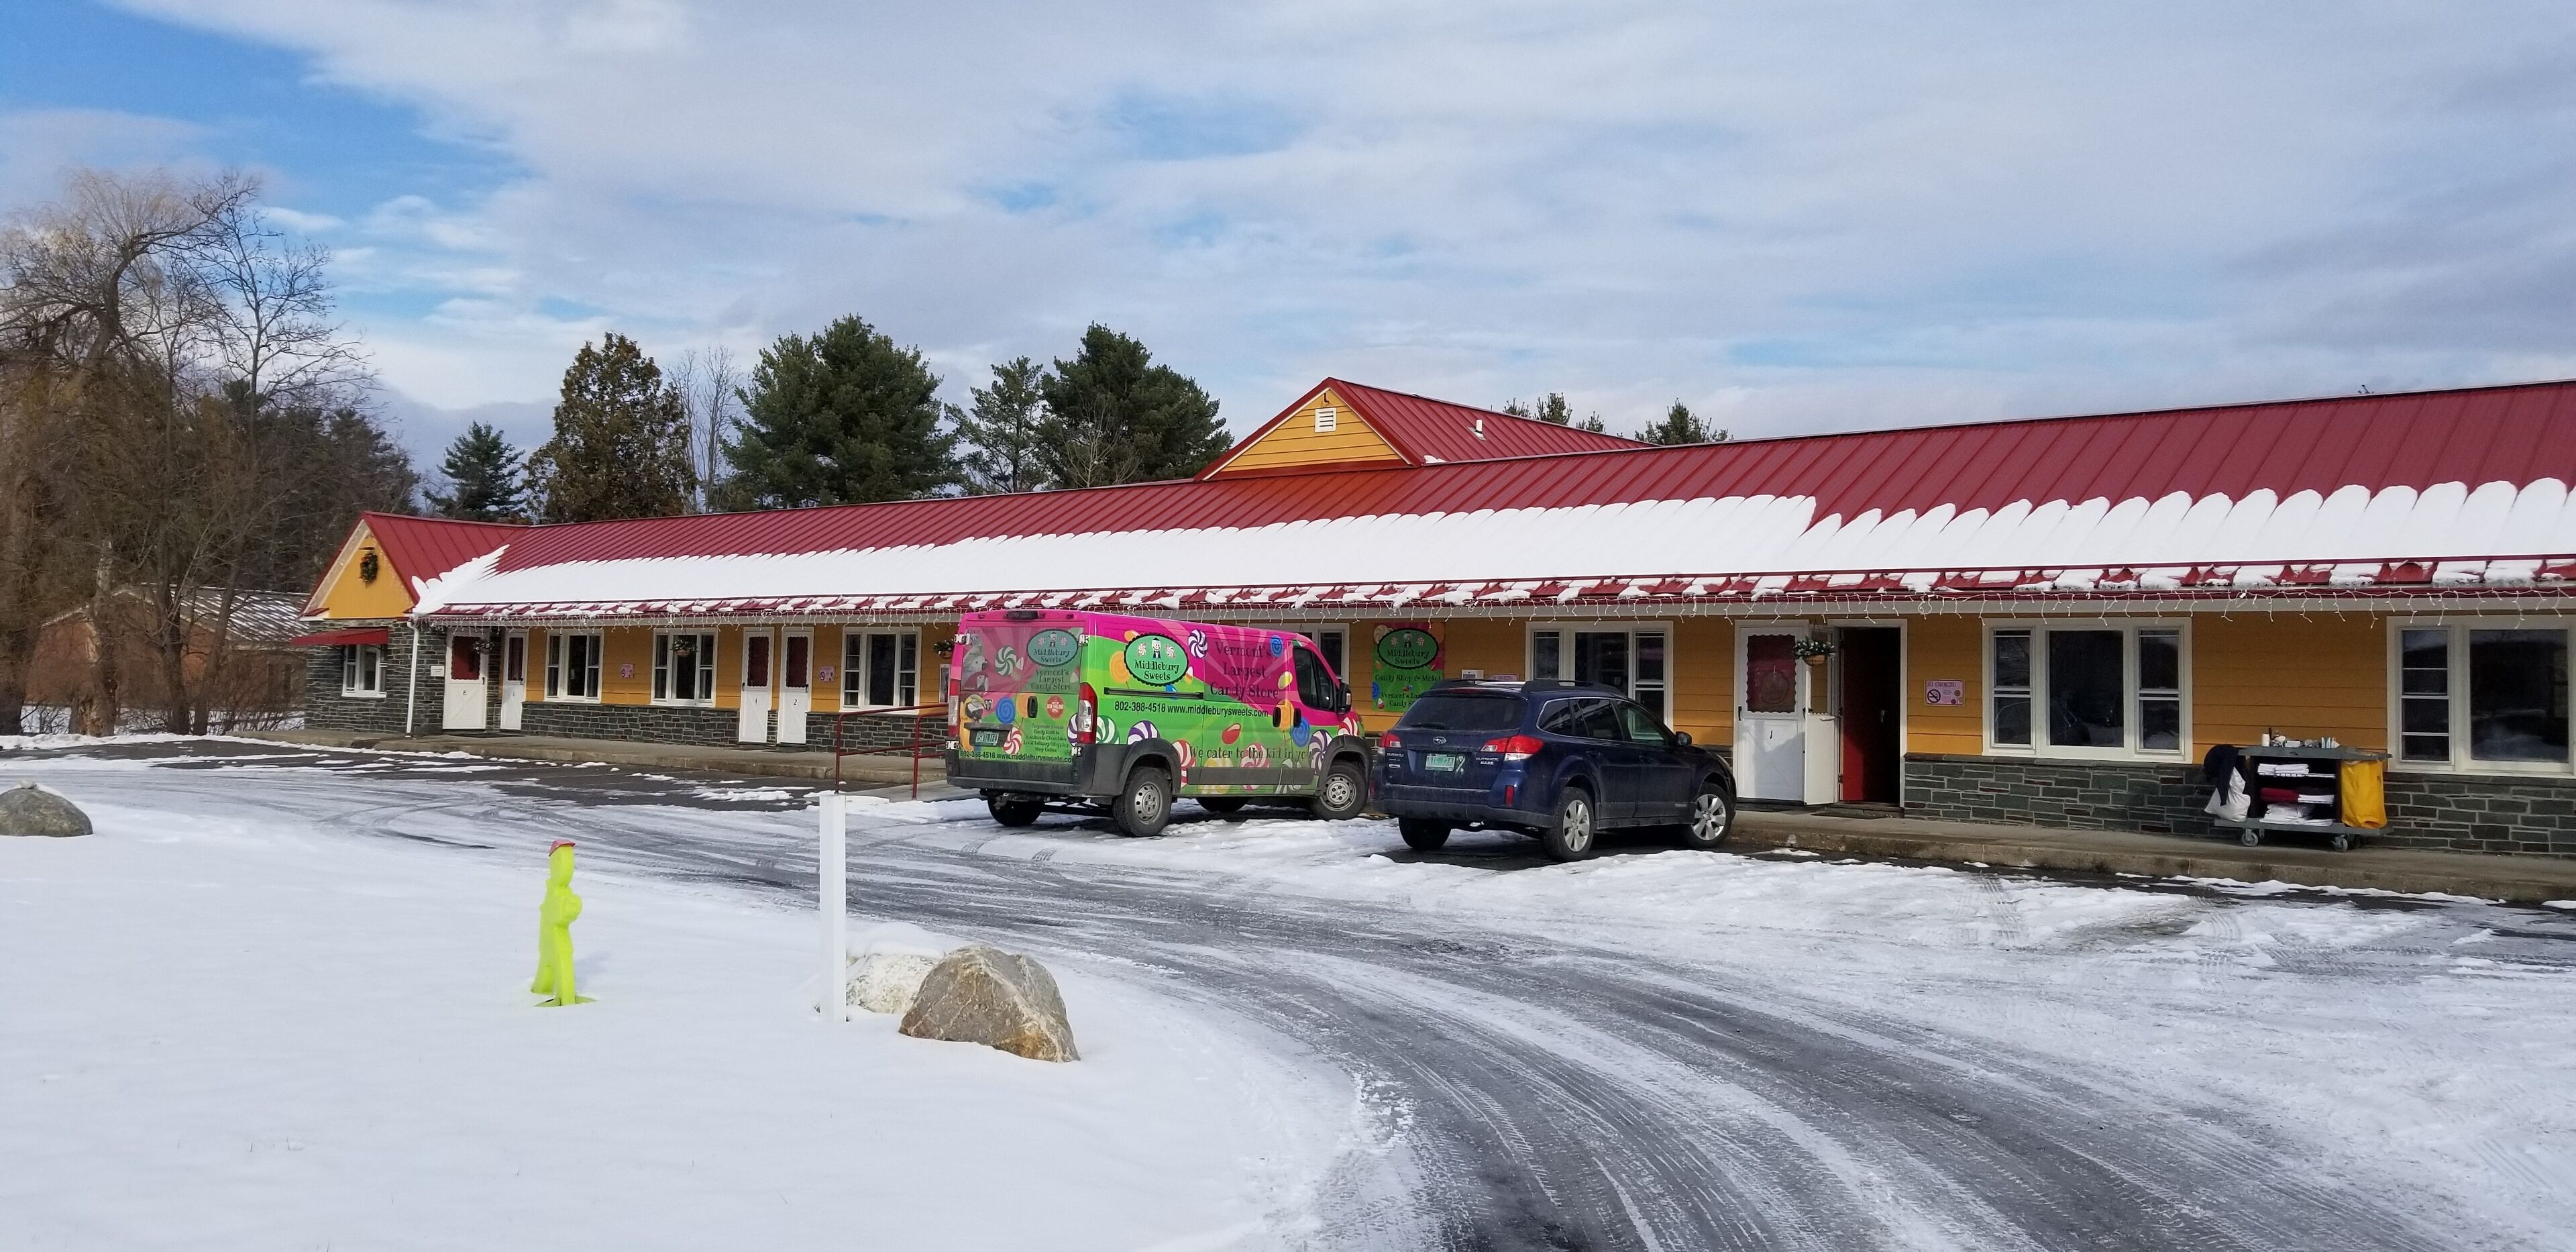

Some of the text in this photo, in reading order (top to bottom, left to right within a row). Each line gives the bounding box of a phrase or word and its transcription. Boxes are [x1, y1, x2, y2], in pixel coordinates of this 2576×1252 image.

[1034, 648, 1071, 658] Middlebury
[1215, 641, 1272, 658] Vermont's
[1134, 660, 1179, 674] Middlebury
[1223, 662, 1267, 680] Largest
[1144, 671, 1171, 681] Sweets
[1375, 674, 1395, 682] Candy
[1210, 682, 1279, 700] Candy Store
[1115, 700, 1269, 717] 802-388-4518 www.middleburysweets.com
[1190, 747, 1203, 758] We
[1207, 747, 1232, 759] cater
[1236, 747, 1245, 759] to
[1248, 747, 1264, 759] the
[1267, 747, 1281, 759] kid
[1285, 748, 1293, 759] in
